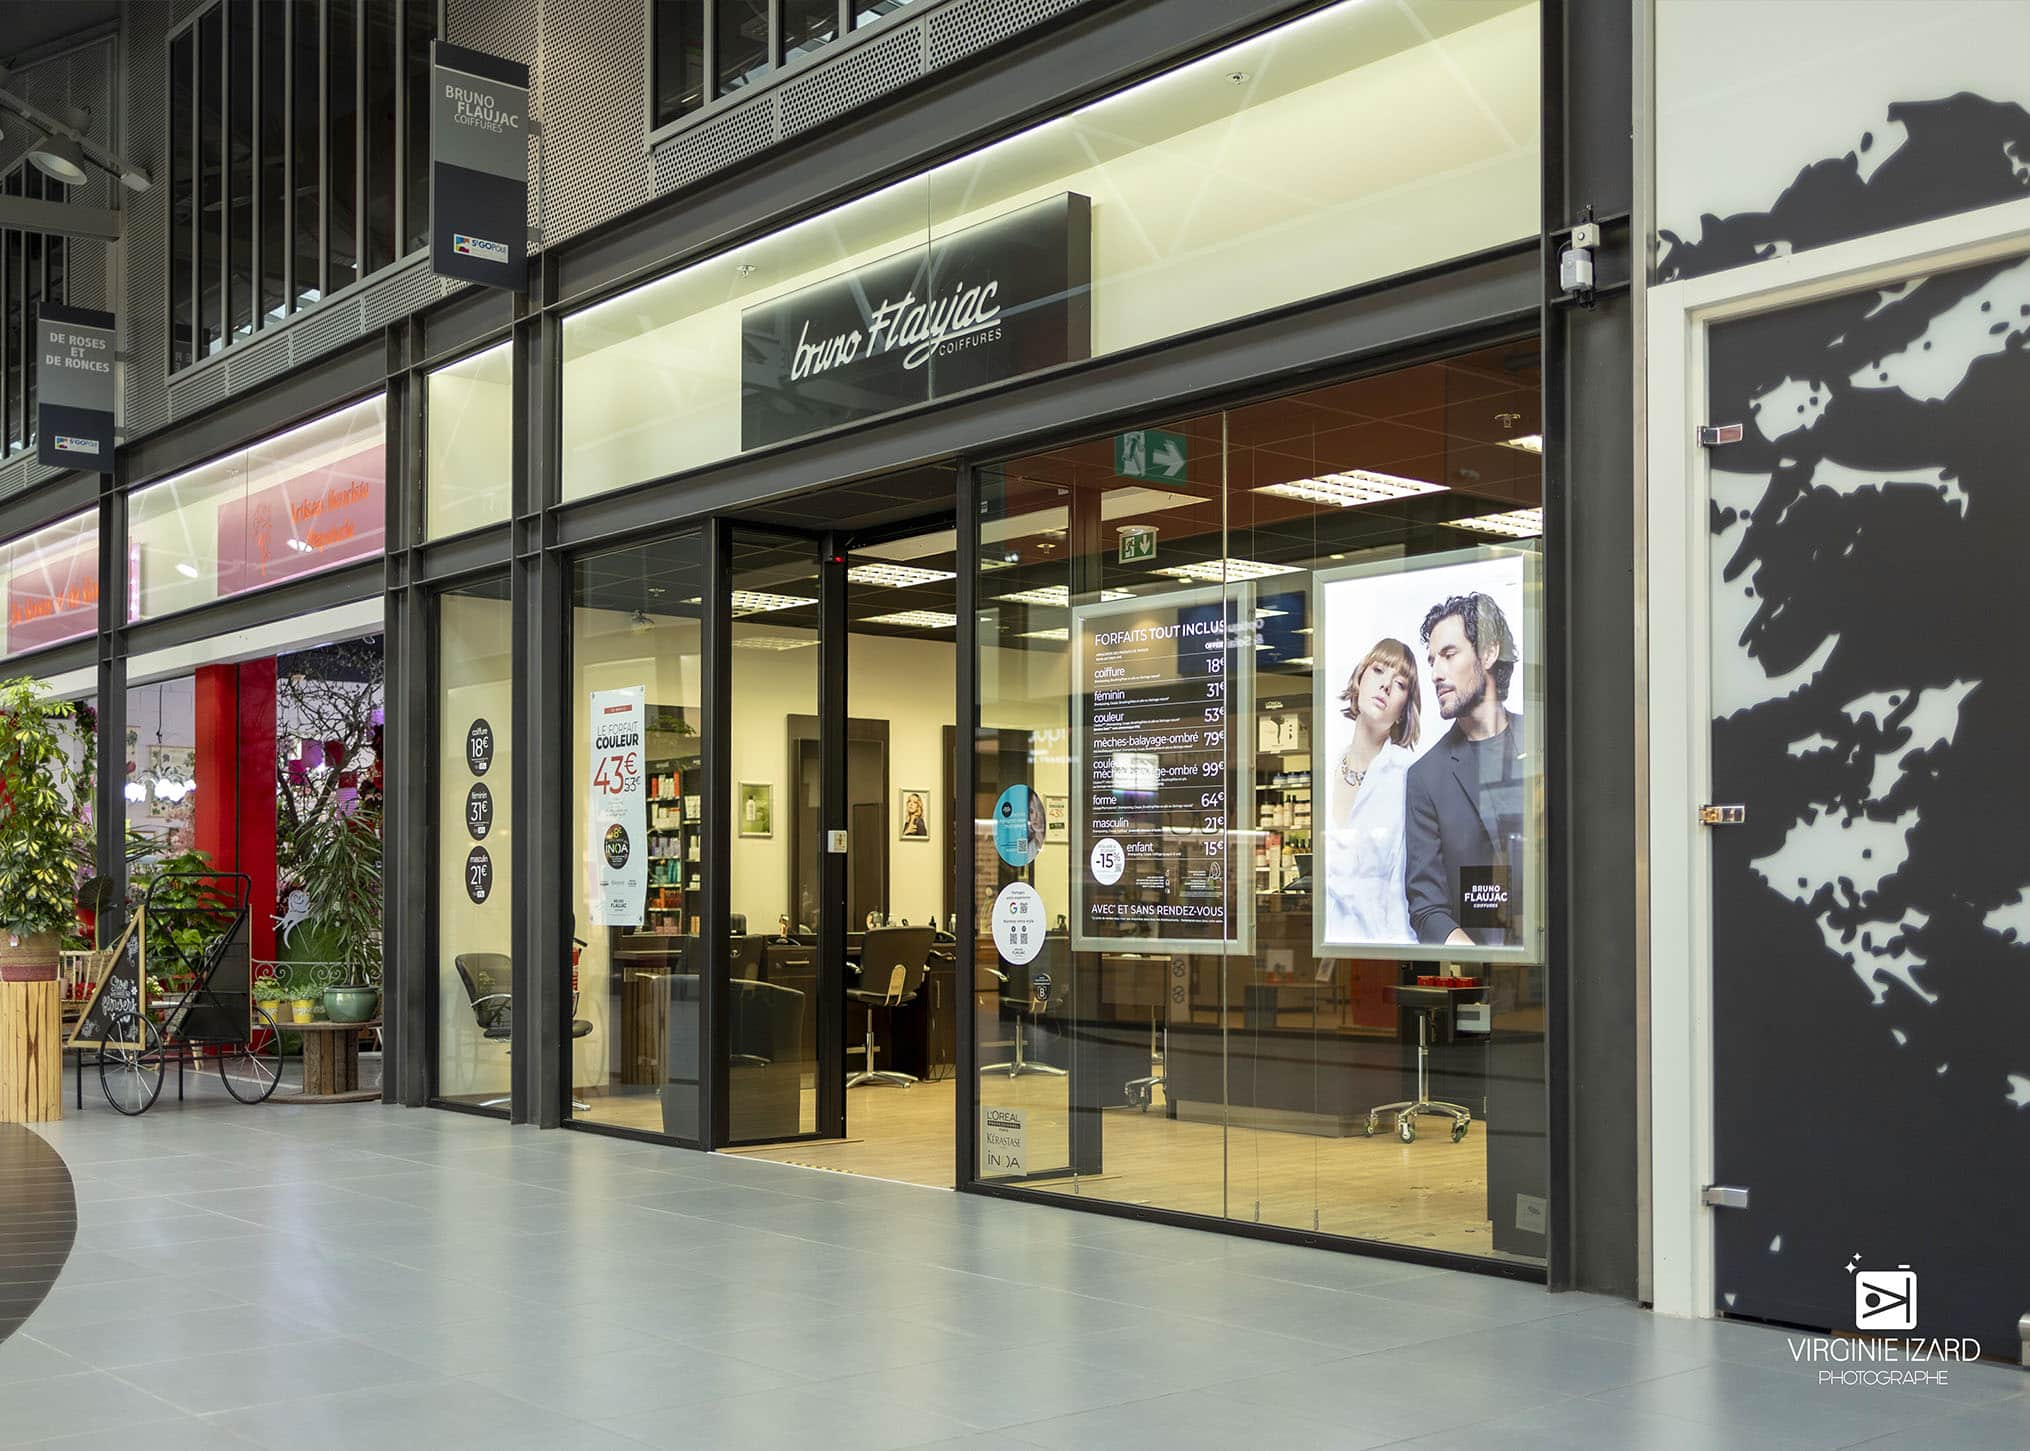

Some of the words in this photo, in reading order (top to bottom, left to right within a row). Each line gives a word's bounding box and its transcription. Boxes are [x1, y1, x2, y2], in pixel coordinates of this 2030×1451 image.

[446, 85, 495, 108] BRUNO
[457, 101, 519, 128] FLAUJAC
[454, 114, 503, 133] COIFFURES
[50, 332, 65, 344] DE
[69, 335, 106, 350] ROSES
[939, 328, 1002, 356] COIFFURES
[71, 347, 86, 358] ET
[790, 319, 862, 381] bruno
[46, 354, 61, 366] DE
[65, 357, 110, 373] RONCES
[1095, 628, 1148, 646] FORFAITS
[1149, 625, 1180, 640] TOUT
[1094, 667, 1126, 679] coiffure
[1094, 690, 1126, 702] féminin
[1094, 712, 1124, 724] couleur
[597, 725, 606, 737] LE
[608, 721, 640, 735] FORFAIT
[471, 736, 489, 758] 18€
[596, 733, 639, 750] COULEUR
[1094, 731, 1199, 749] mèches-balayage-ombré
[593, 751, 637, 795] 43€
[1202, 760, 1225, 777] 99€
[1092, 793, 1118, 805] forme
[1201, 792, 1225, 807] 64€
[470, 800, 488, 821] 31€
[1092, 816, 1129, 828] masculin
[1204, 816, 1225, 832] 21€
[1126, 841, 1154, 853] enfant
[1203, 840, 1225, 856] 15€
[470, 864, 488, 885] 21€
[1464, 892, 1508, 902] FLAUJAC
[1472, 884, 1501, 893] BRUNO
[1118, 904, 1129, 915] ET
[1130, 905, 1155, 916] SANS
[1157, 905, 1224, 917] RENDEZ-VOUS
